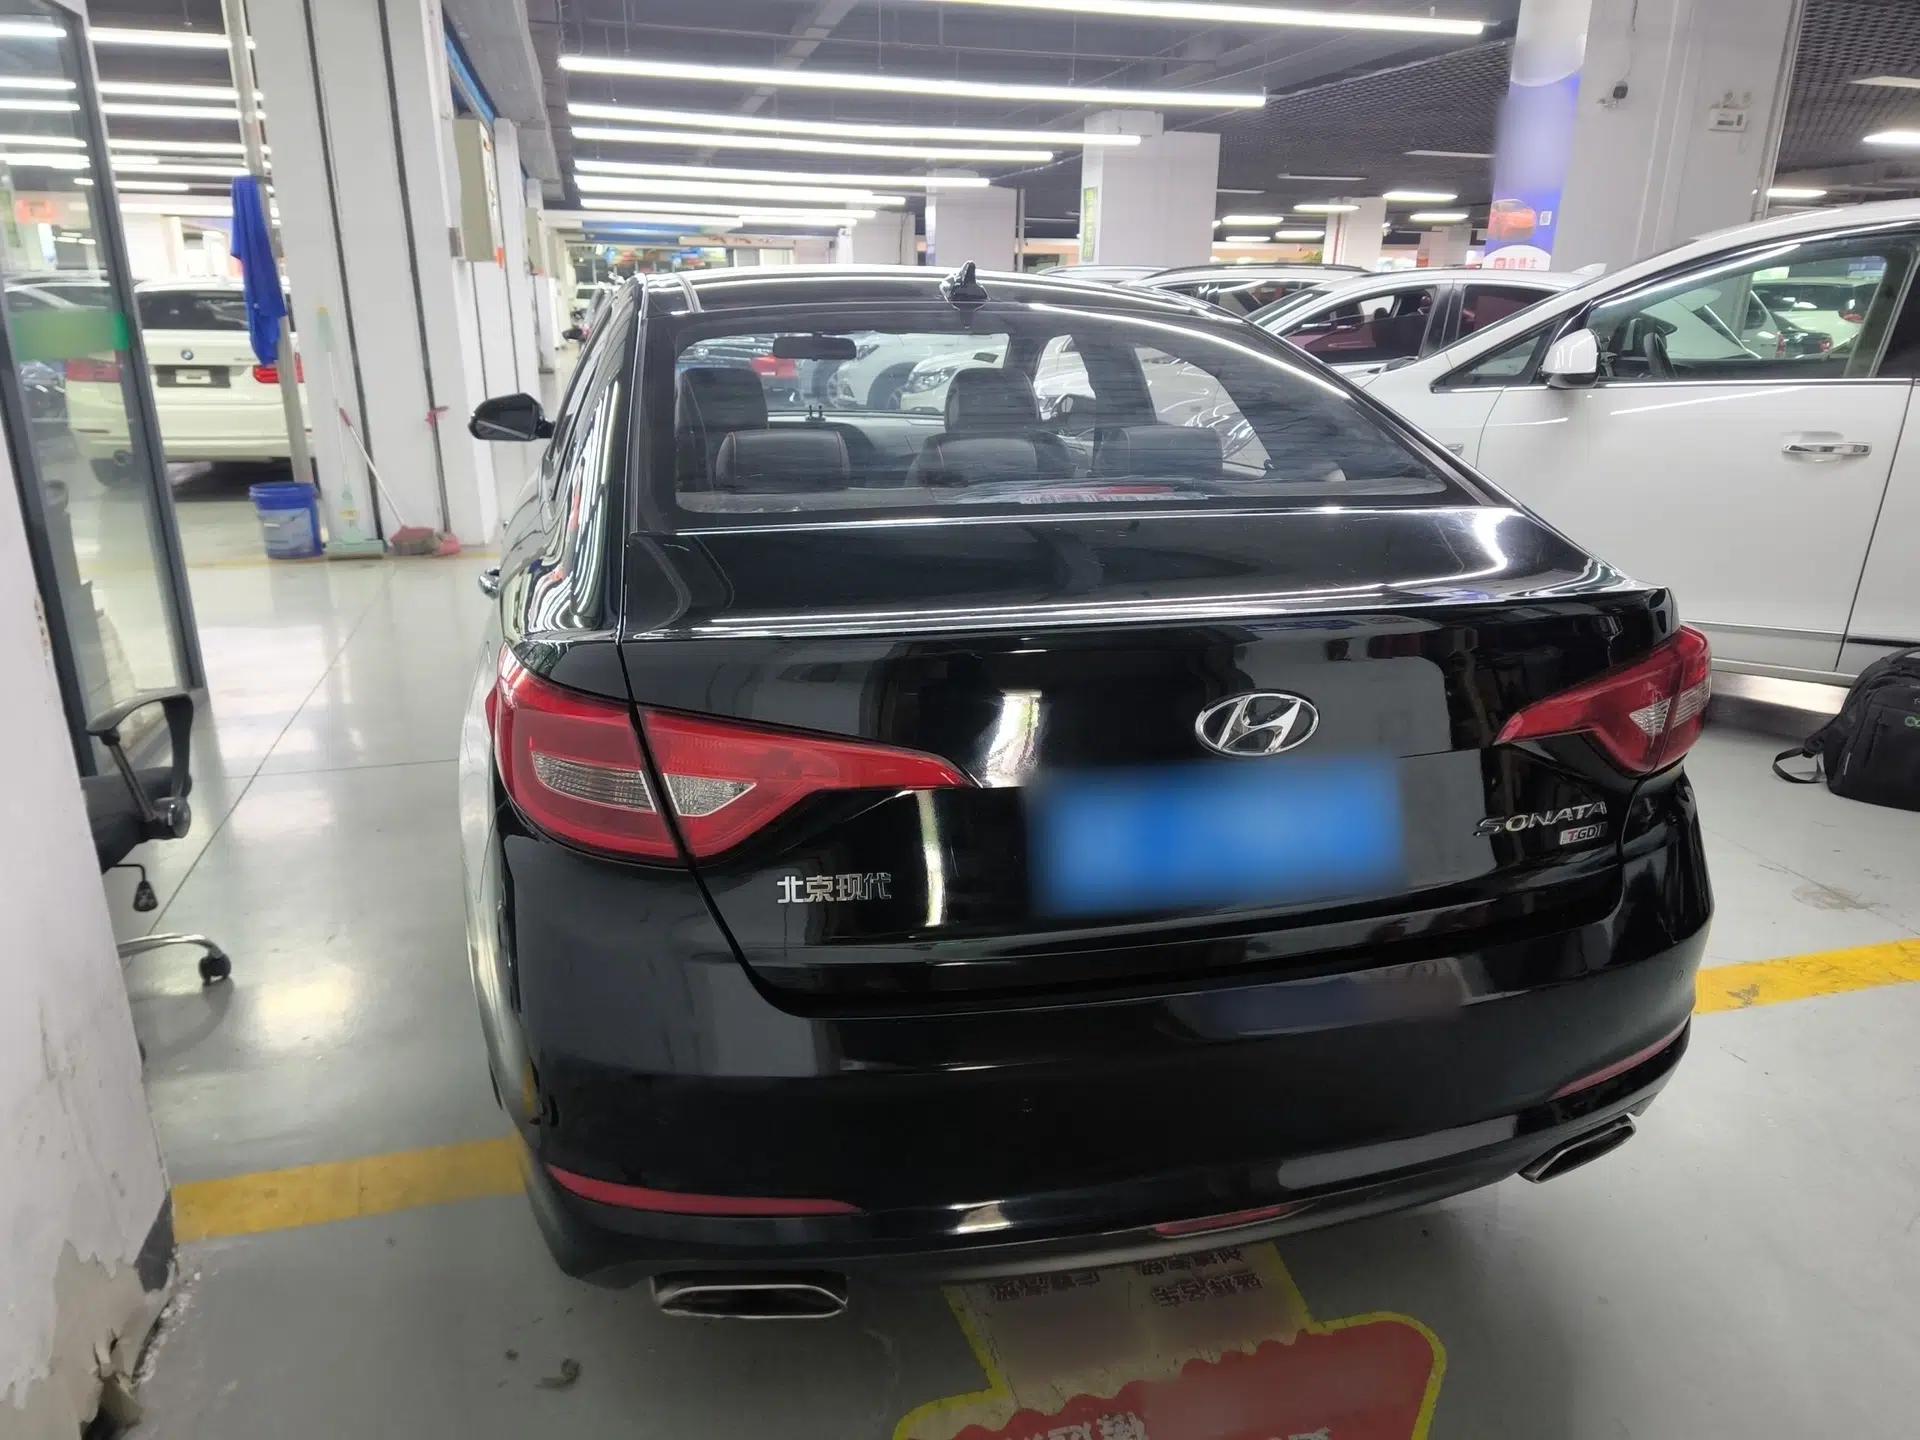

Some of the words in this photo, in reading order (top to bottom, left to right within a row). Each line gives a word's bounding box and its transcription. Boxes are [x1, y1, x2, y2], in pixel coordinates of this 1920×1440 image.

[1473, 801, 1607, 836] SONATA
[776, 872, 892, 904] 北京现代
